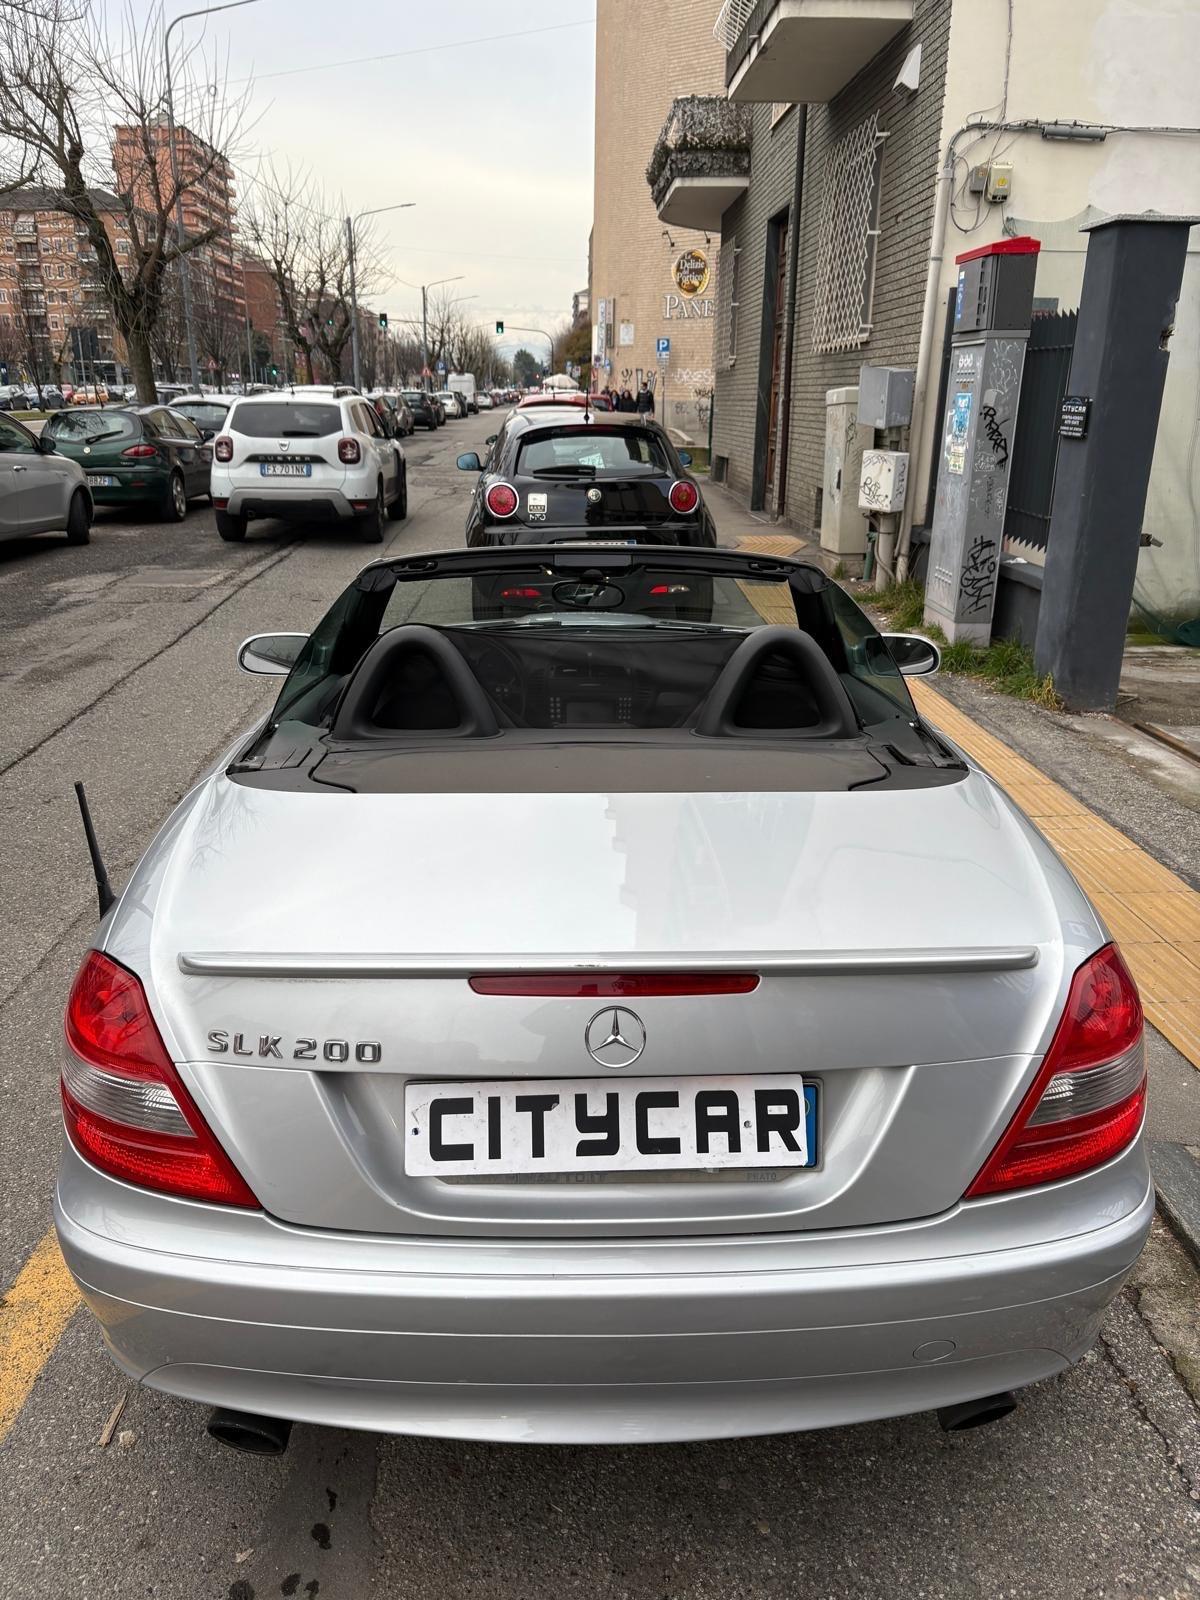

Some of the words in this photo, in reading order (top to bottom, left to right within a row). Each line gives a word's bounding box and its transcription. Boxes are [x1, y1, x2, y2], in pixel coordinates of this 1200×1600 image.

[679, 259, 706, 270] Delizie
[677, 272, 704, 283] Portico
[663, 294, 715, 319] PANE
[659, 340, 669, 352] P
[207, 1029, 283, 1060] SLK
[293, 1038, 382, 1063] 200
[429, 1088, 802, 1162] CITYCAR
